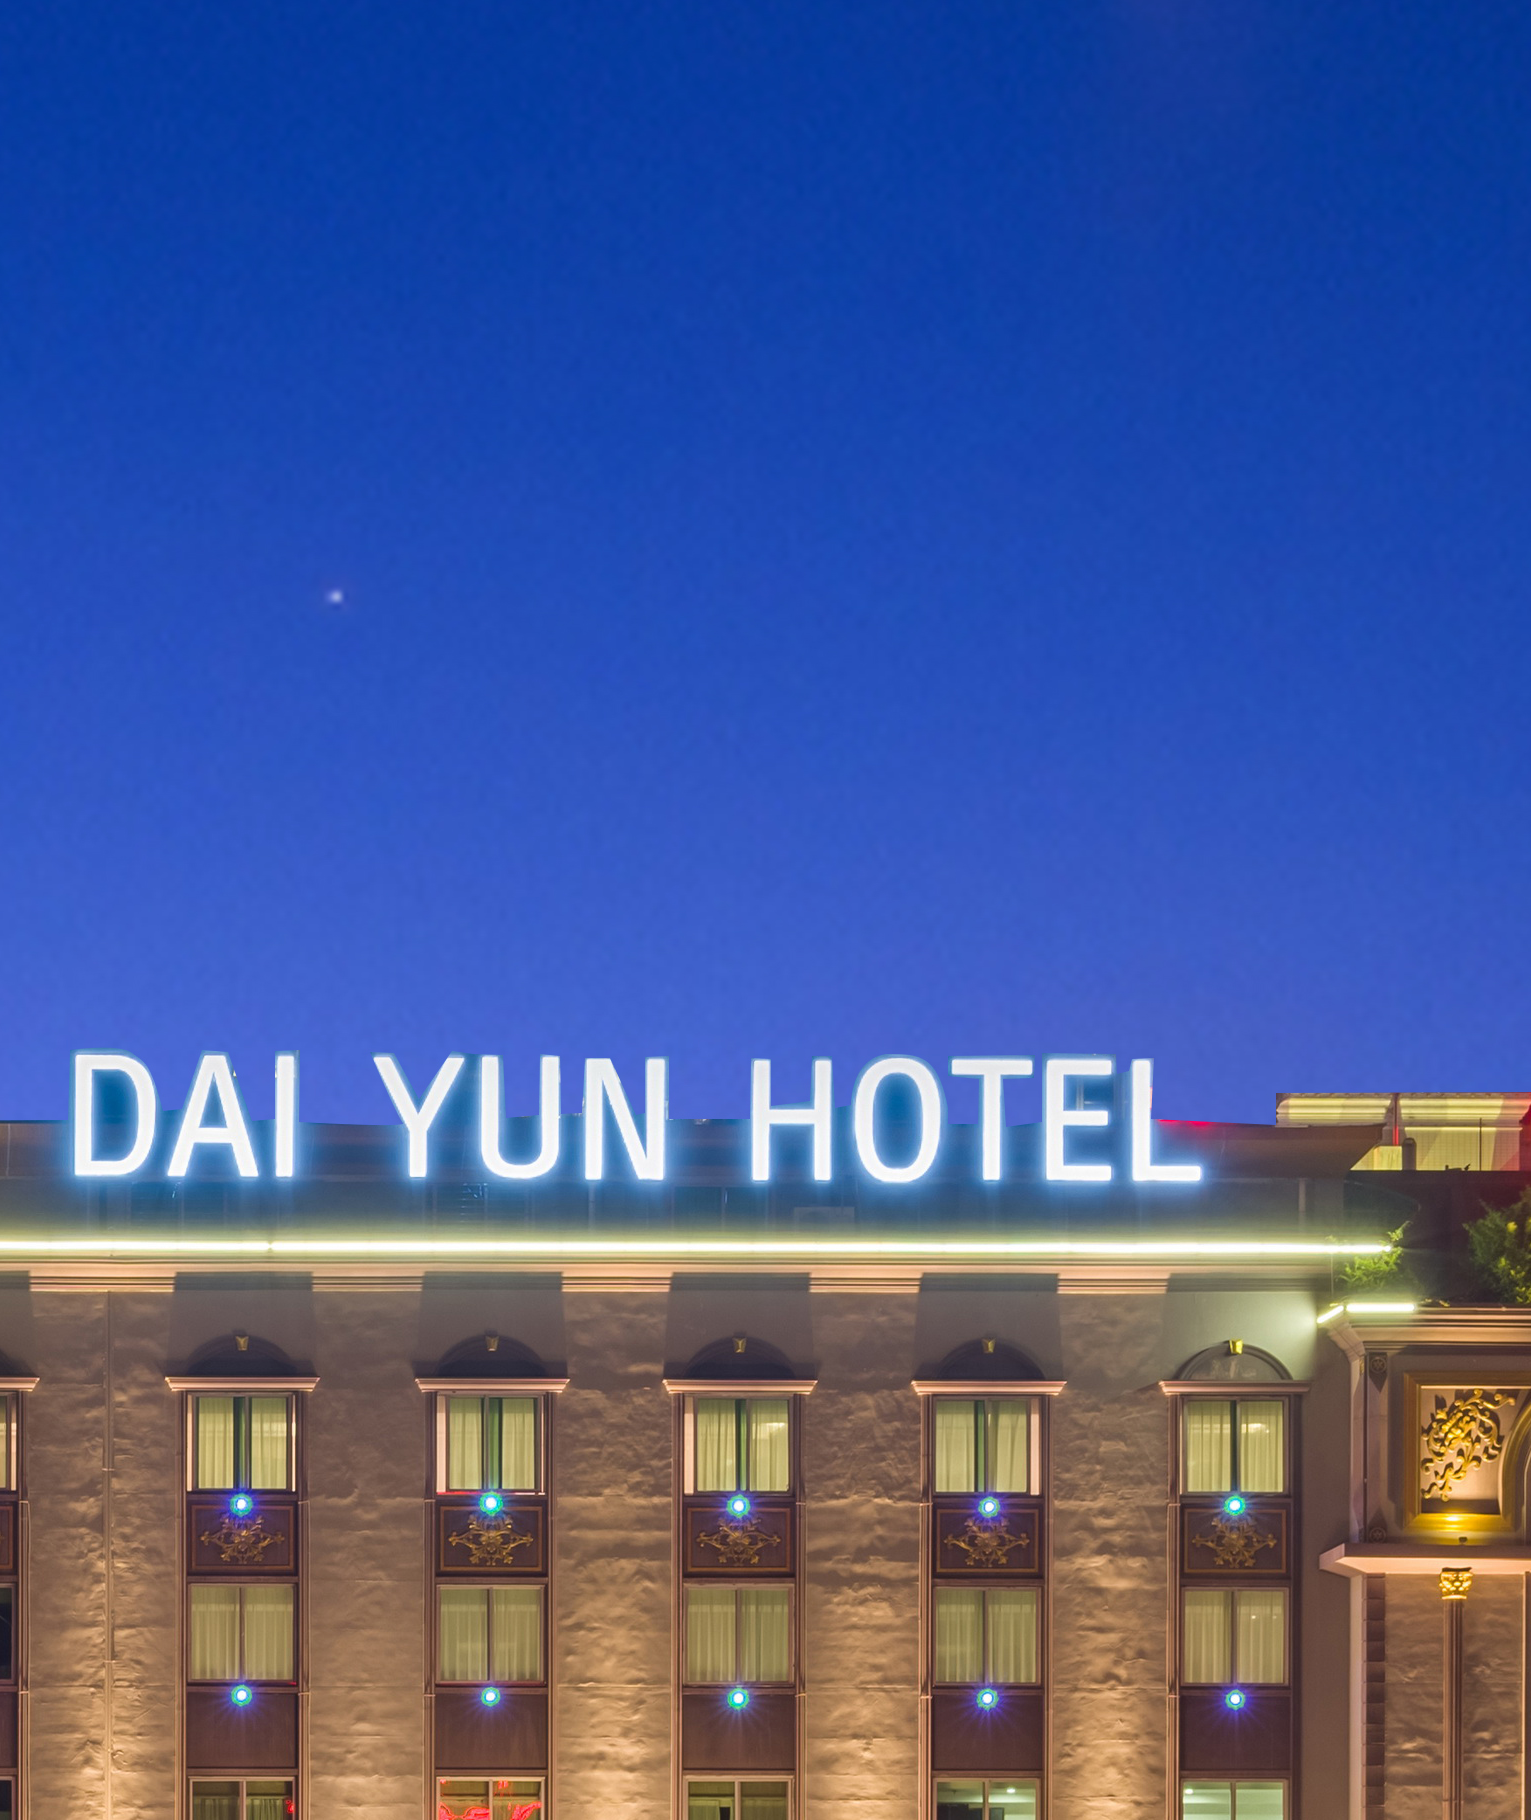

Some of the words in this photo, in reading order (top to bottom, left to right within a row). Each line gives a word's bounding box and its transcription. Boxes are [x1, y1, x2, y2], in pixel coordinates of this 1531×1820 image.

[73, 1052, 297, 1178] DAI
[372, 1054, 666, 1181] YUN
[750, 1055, 1204, 1183] HOTEL
